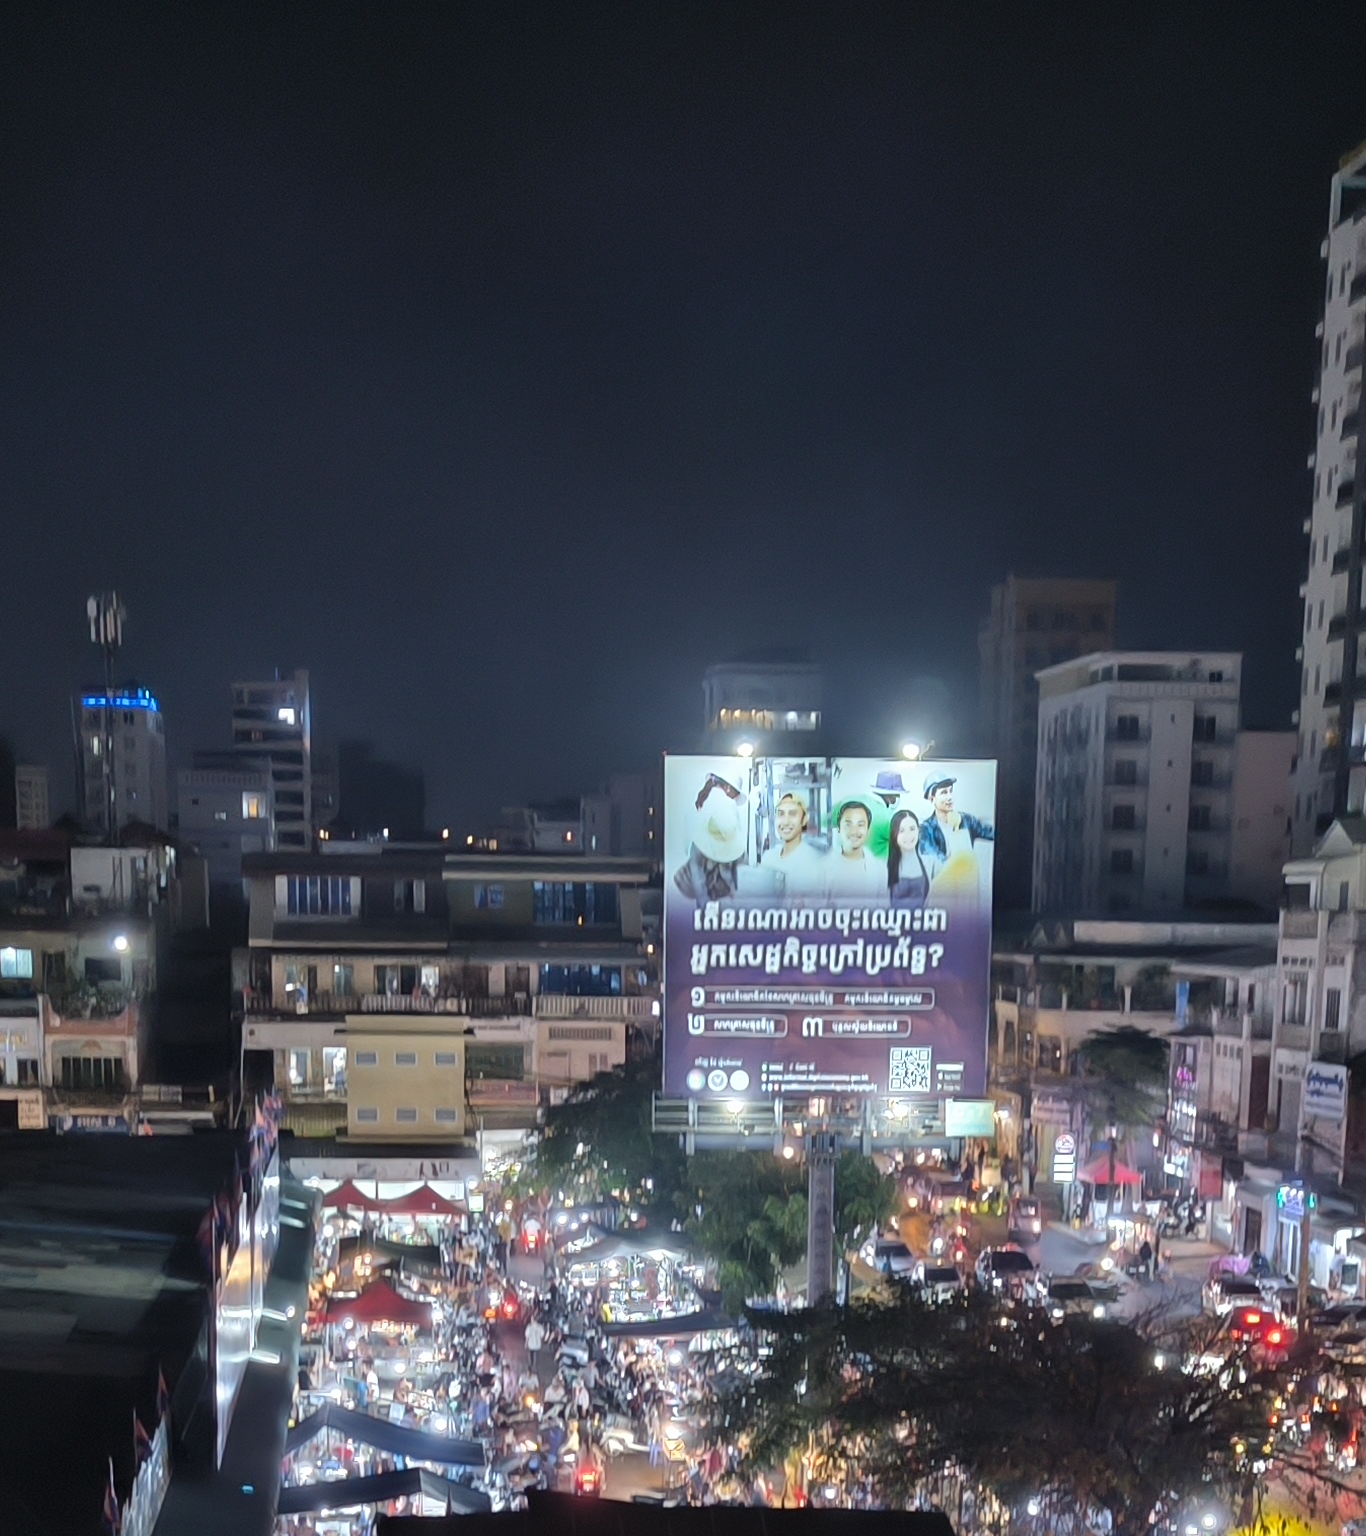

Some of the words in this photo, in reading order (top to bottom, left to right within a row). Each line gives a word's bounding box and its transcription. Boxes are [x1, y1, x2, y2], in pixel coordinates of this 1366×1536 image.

[691, 987, 705, 1007] ១
[688, 1013, 704, 1034] ២
[802, 1016, 823, 1036] ៣
